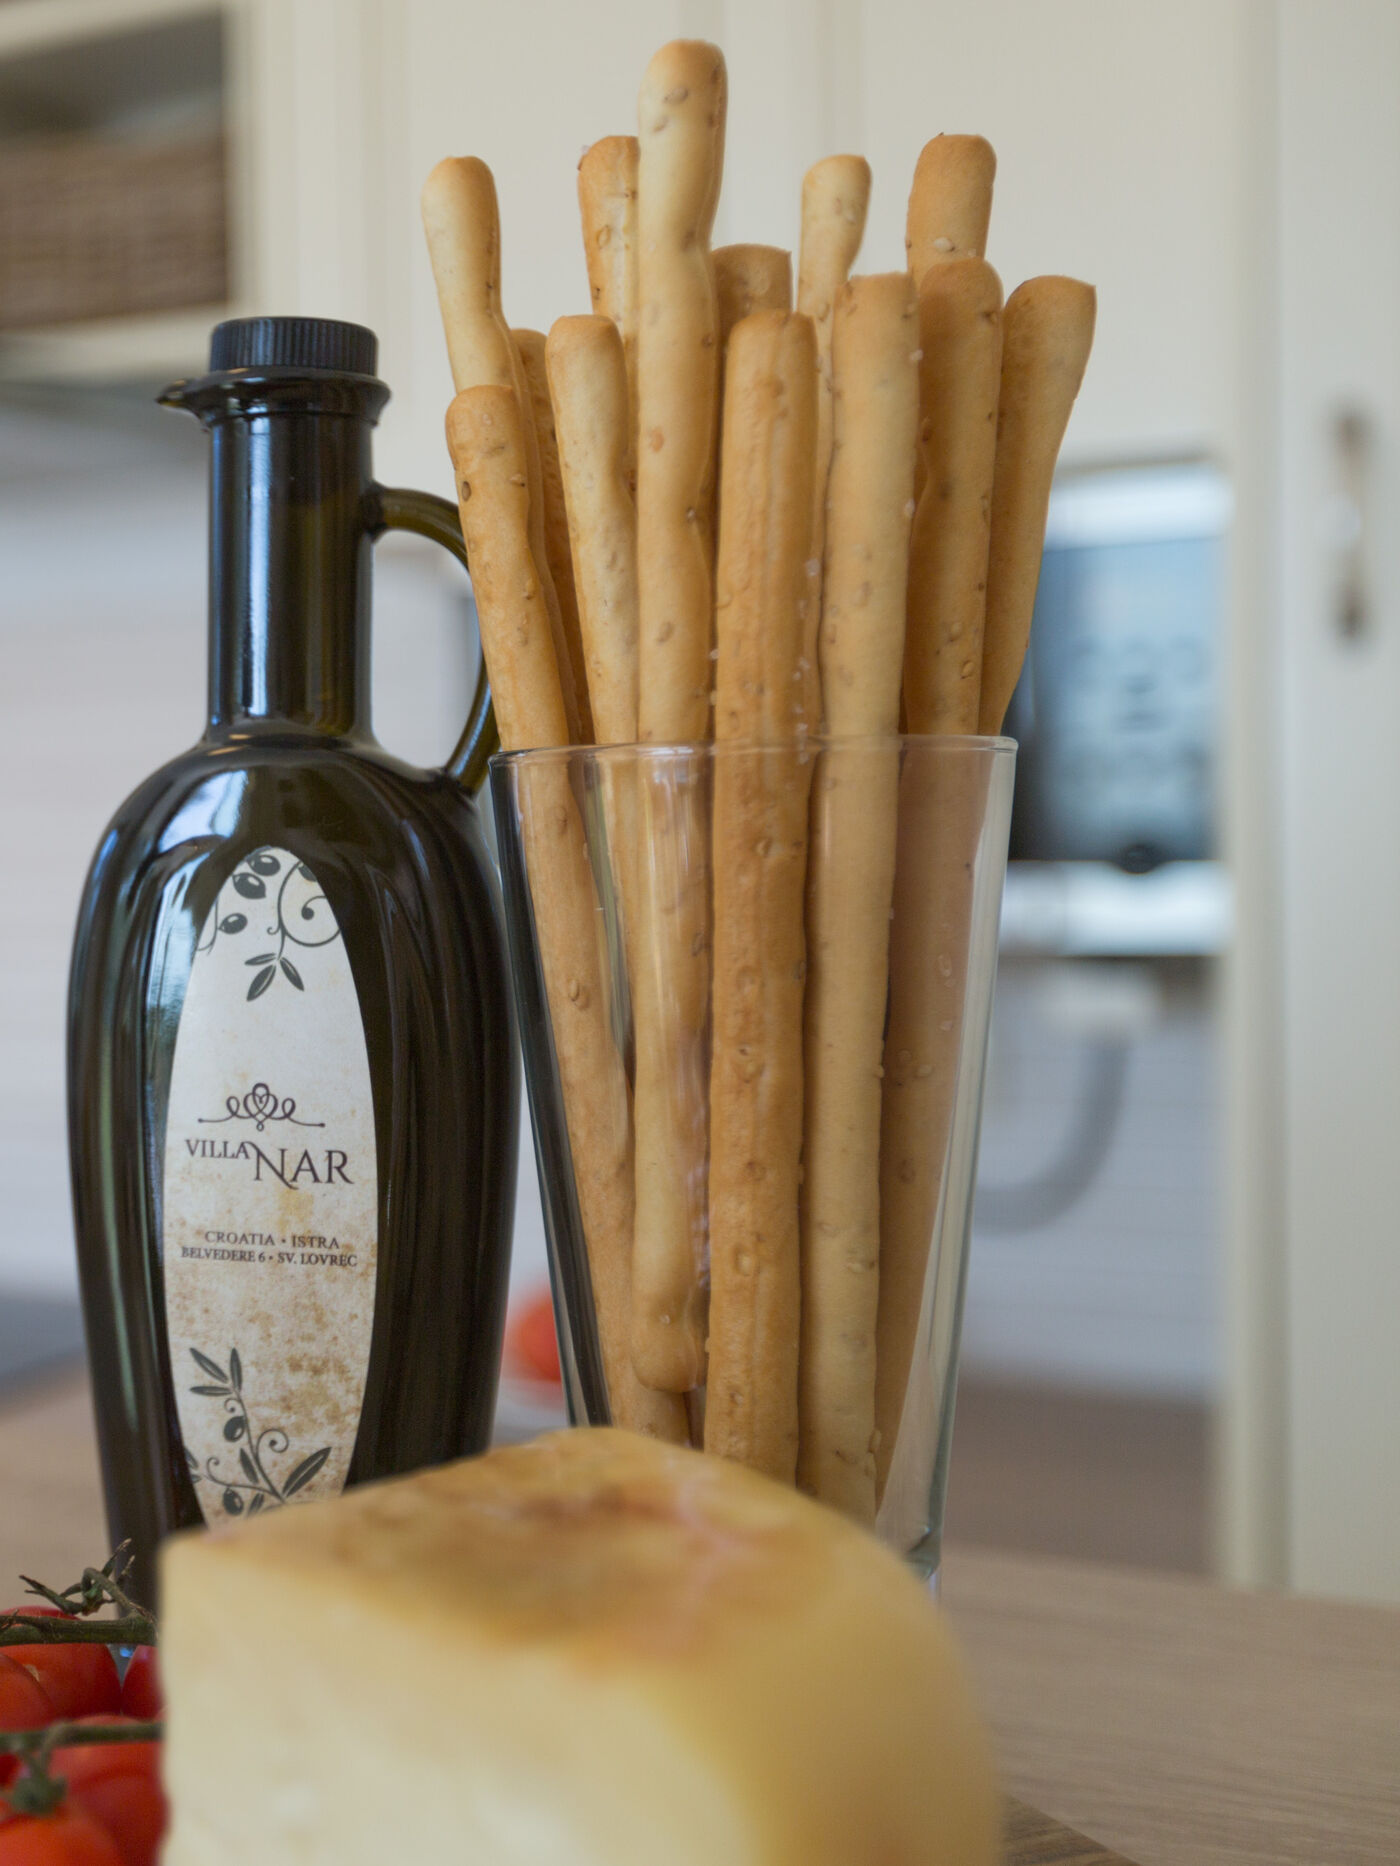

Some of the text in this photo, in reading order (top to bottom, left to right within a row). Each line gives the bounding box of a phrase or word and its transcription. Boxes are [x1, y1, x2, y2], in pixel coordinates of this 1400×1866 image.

[185, 1139, 354, 1190] VILLA NAR
[205, 1231, 340, 1249] CROATIA ISTRA
[181, 1247, 256, 1262] BELVEDERE
[257, 1252, 266, 1263] 6
[277, 1253, 297, 1265] SV.
